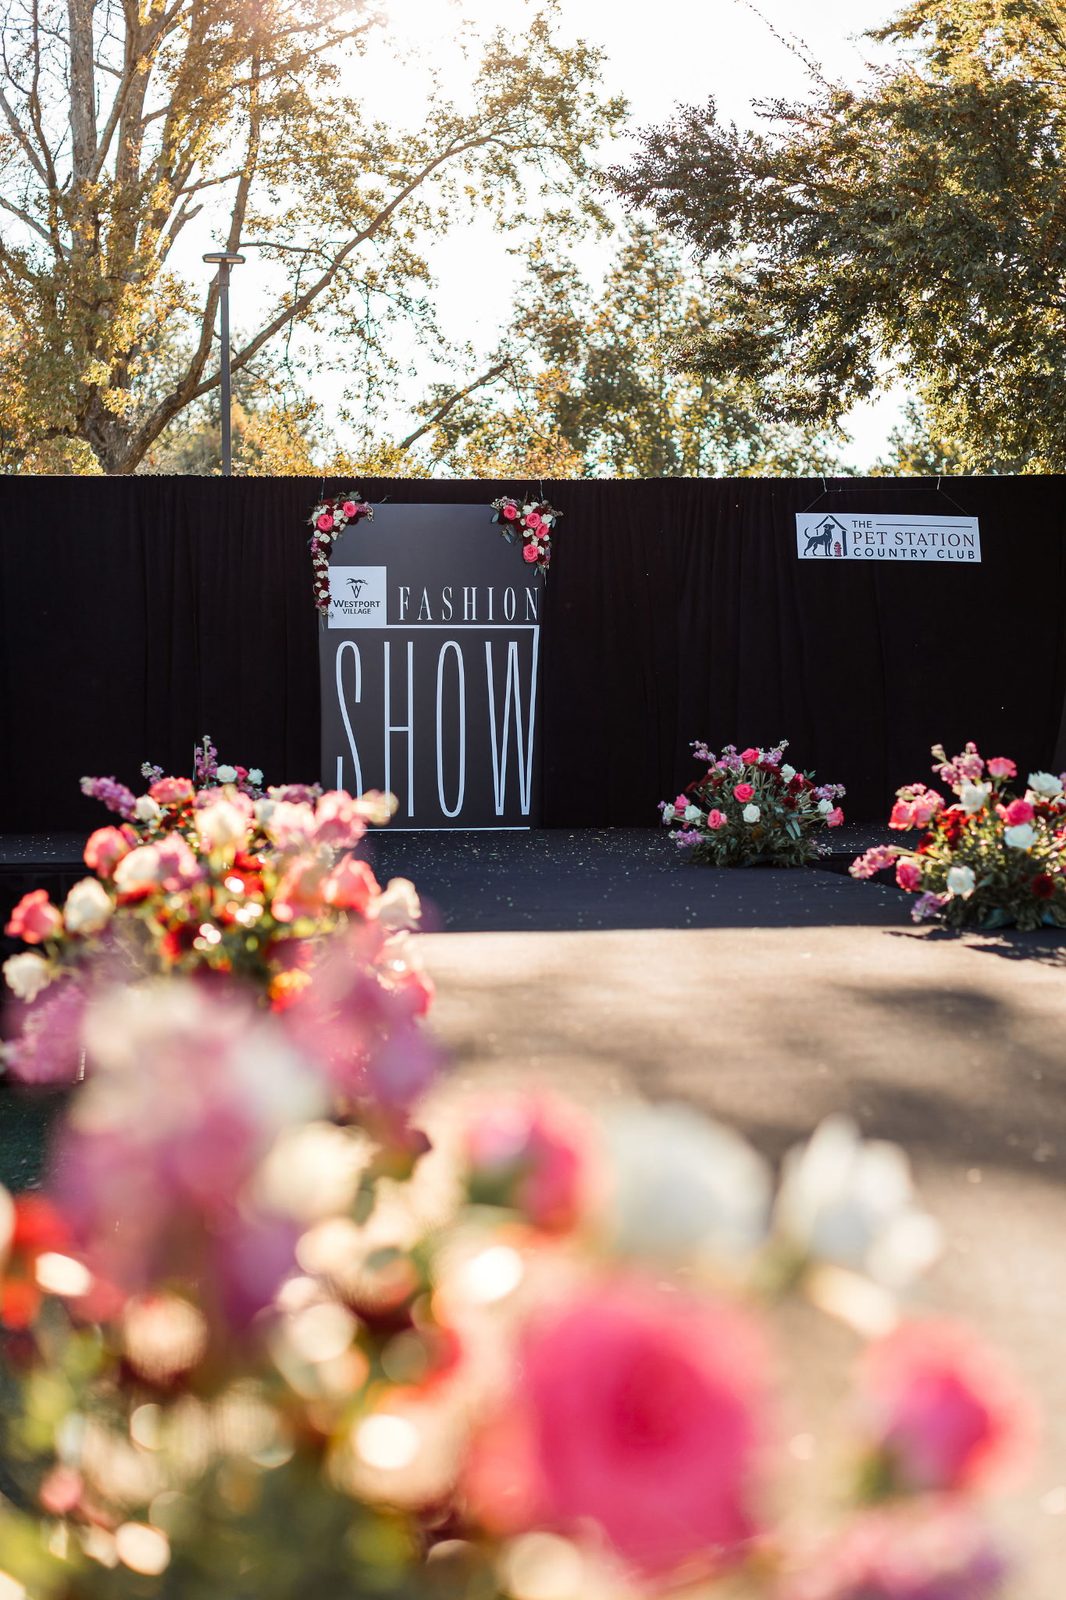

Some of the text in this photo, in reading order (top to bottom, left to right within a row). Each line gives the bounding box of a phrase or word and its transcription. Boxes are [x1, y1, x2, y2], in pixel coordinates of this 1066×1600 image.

[852, 520, 872, 528] THE
[853, 531, 974, 547] PET STATION
[854, 547, 975, 560] COUNTRY CLUB
[398, 586, 539, 621] FASHION
[336, 626, 540, 817] SHOW
